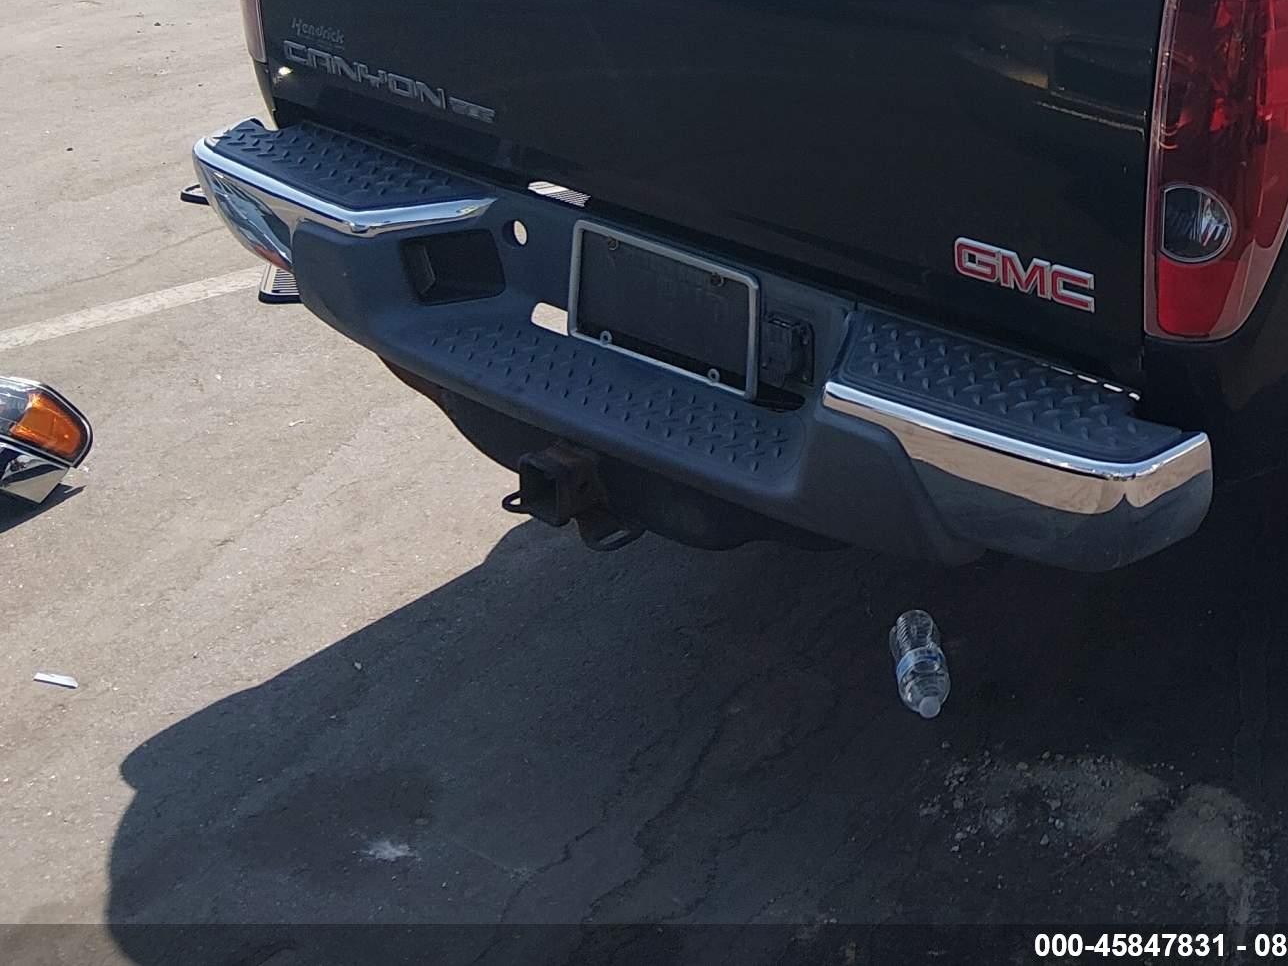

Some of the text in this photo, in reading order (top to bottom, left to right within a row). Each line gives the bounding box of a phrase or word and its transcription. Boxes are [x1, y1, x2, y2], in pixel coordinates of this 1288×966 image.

[291, 17, 345, 44] Hendrick
[284, 40, 447, 110] CANYON
[955, 237, 1095, 313] GMC
